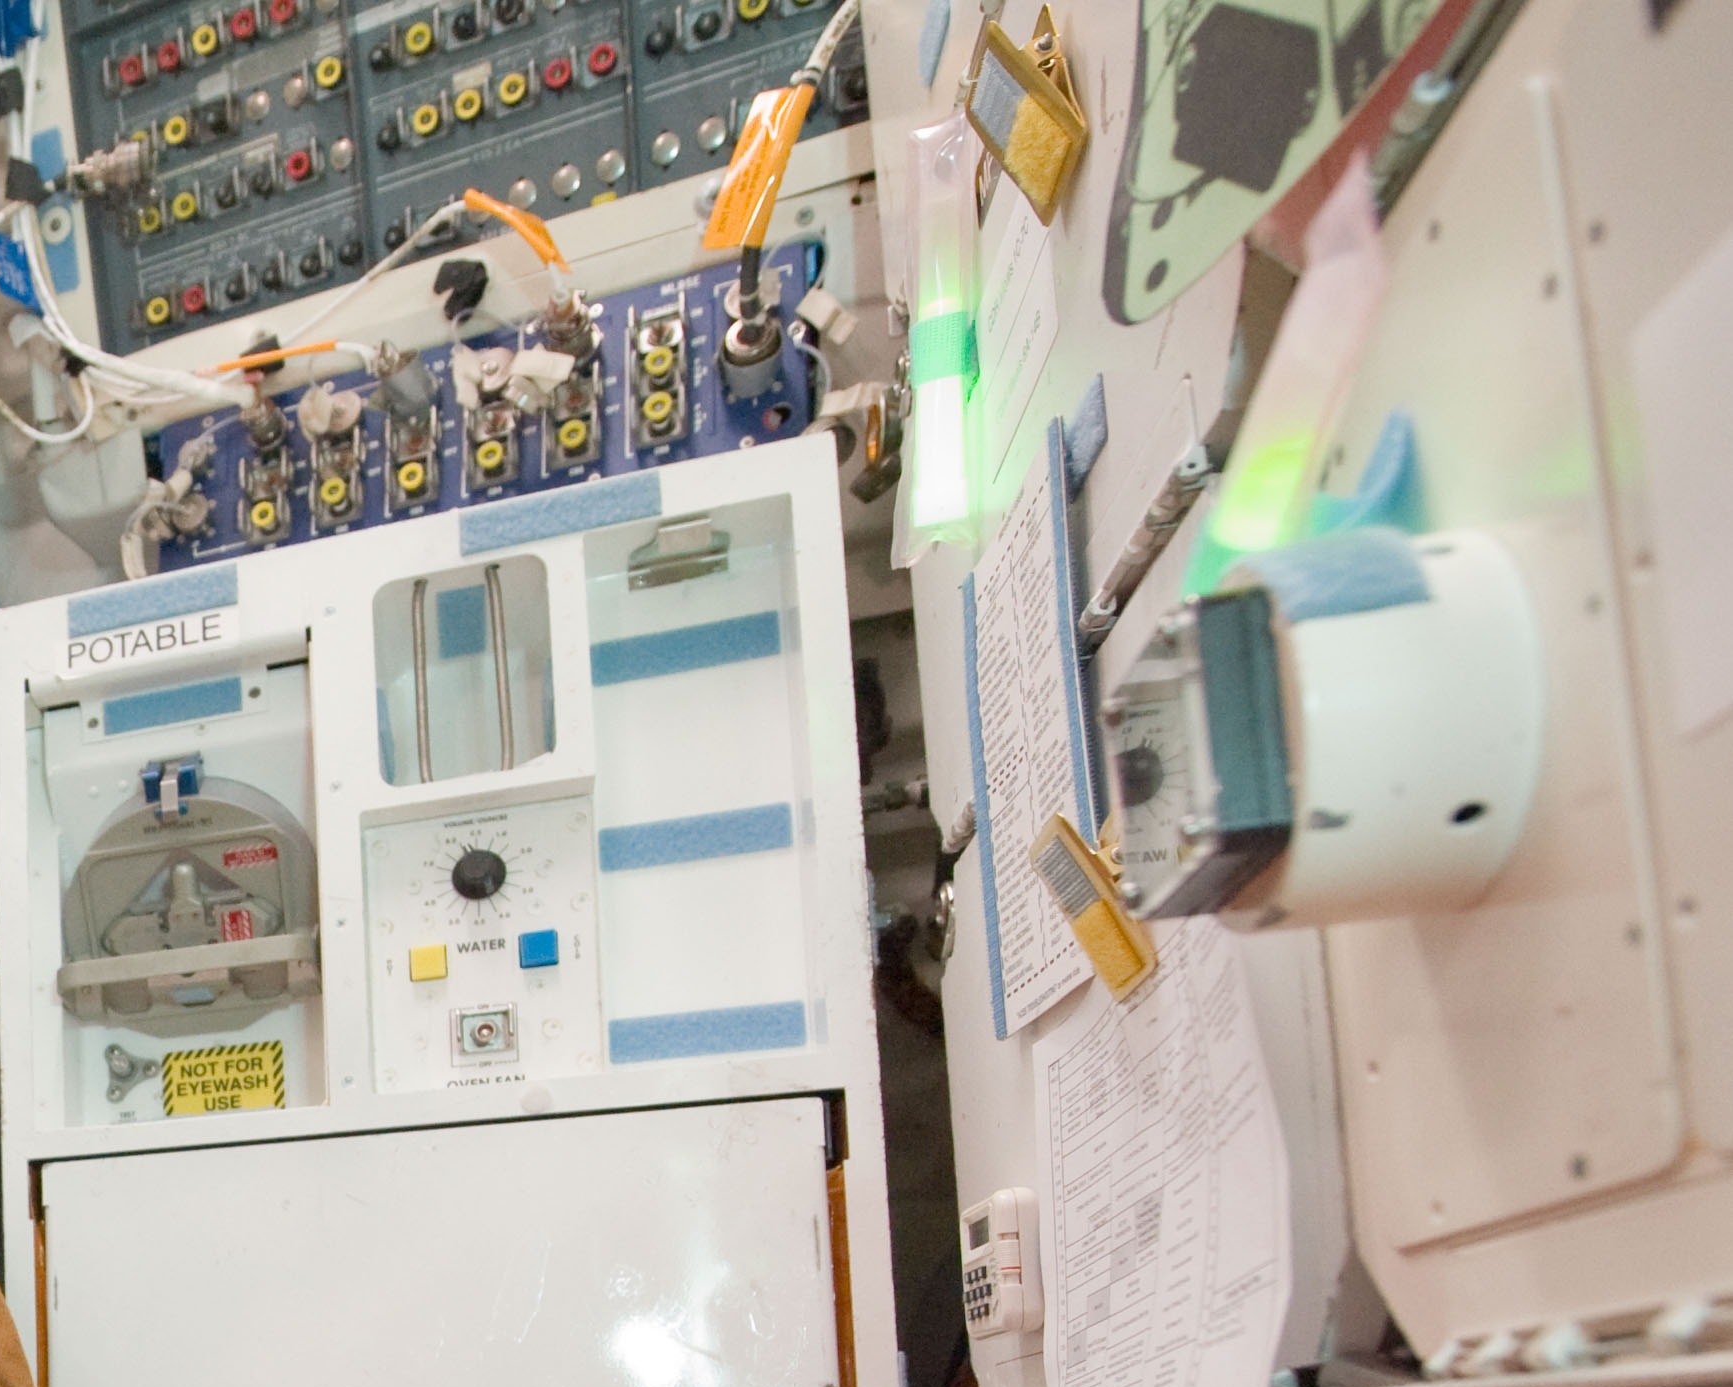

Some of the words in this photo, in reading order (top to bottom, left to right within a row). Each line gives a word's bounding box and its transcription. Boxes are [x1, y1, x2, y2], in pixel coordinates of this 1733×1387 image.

[68, 613, 221, 669] POTABLE
[457, 938, 507, 954] WATER
[180, 1062, 218, 1078] NOT
[224, 1057, 263, 1073] FOR
[176, 1074, 269, 1097] EYEWASH
[204, 1094, 242, 1112] USE
